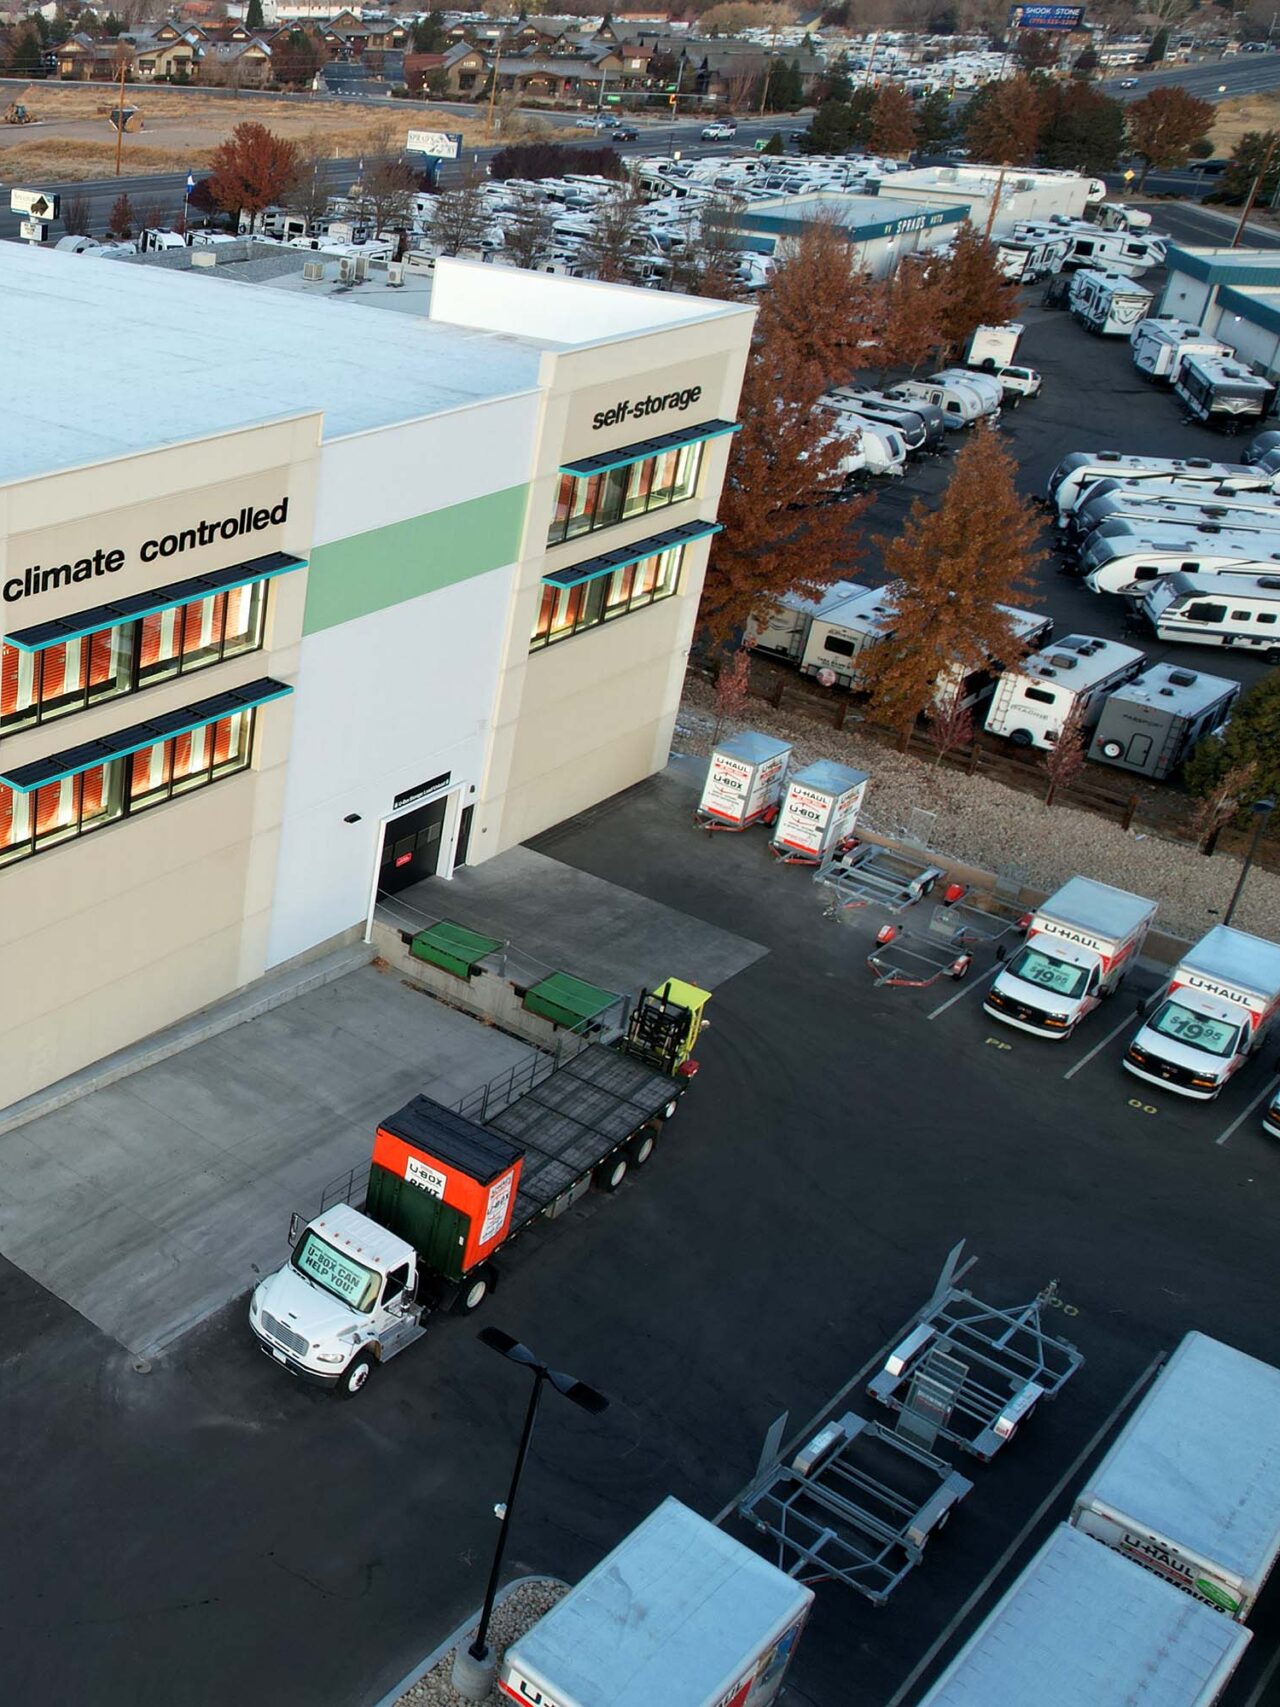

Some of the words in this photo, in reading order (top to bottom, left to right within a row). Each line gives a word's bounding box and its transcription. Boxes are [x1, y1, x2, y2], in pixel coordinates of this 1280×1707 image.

[592, 385, 702, 430] self-storage
[2, 549, 125, 602] climate
[140, 497, 289, 563] controlled
[716, 757, 748, 773] U-HAUL
[713, 773, 743, 789] U-BOX
[793, 787, 827, 803] U-HAUL
[789, 804, 822, 820] U-BOX
[1044, 923, 1100, 951] U-HAUL
[1189, 977, 1251, 1007] U-HAUL
[409, 1163, 442, 1187] U-BOX
[305, 1256, 329, 1275] HELP
[330, 1273, 355, 1294] YOU!
[307, 1246, 337, 1272] U-BOX
[337, 1268, 360, 1287] CAN
[1123, 1533, 1195, 1579] U-HAUL
